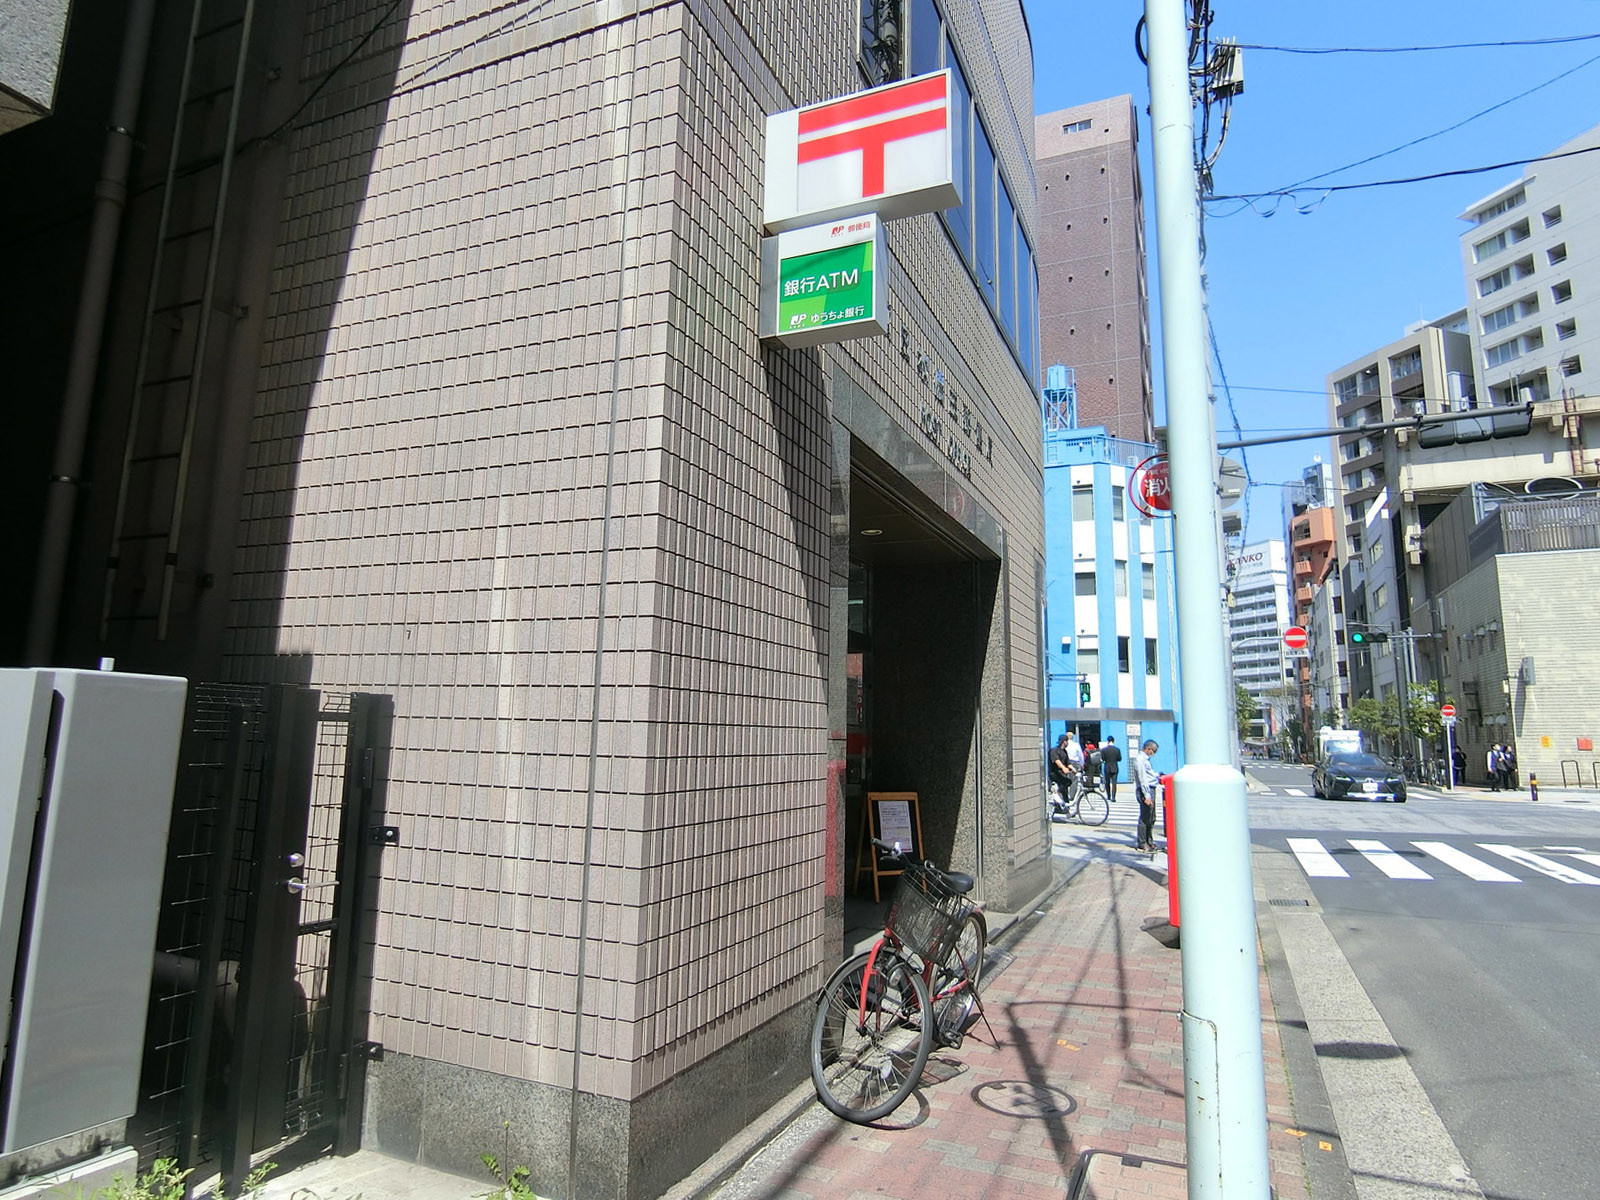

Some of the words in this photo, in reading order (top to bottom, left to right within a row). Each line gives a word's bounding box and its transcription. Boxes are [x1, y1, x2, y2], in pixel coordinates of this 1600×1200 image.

[847, 221, 870, 232] 郵便局
[784, 268, 858, 297] 銀行ATM
[790, 313, 807, 326] JP
[811, 305, 865, 324] ゆうちょ銀行
